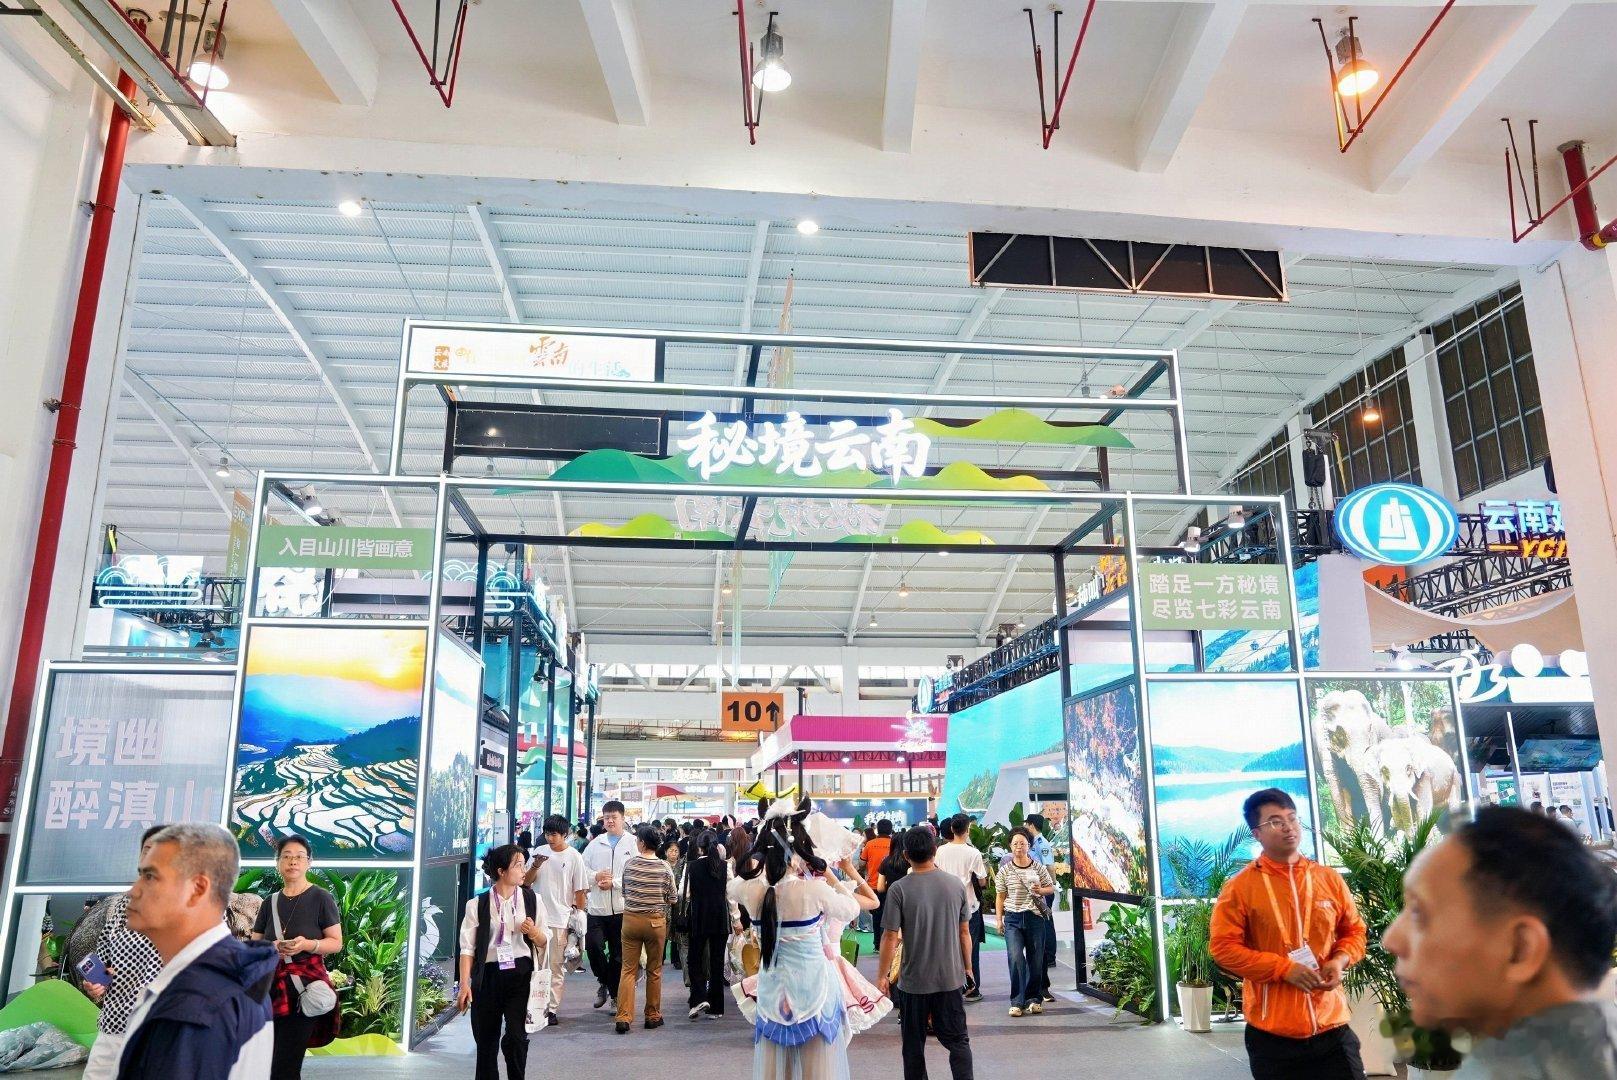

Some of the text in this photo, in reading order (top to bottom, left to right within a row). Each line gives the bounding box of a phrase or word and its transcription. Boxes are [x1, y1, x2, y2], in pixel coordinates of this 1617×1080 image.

[677, 408, 931, 486] 秘境云南
[278, 537, 413, 558] 入目山川皆画意
[1149, 573, 1279, 595] 踏足一方秘境
[1152, 598, 1281, 620] 尽览七彩云南
[727, 701, 762, 722] 10
[55, 716, 166, 766] 境幽
